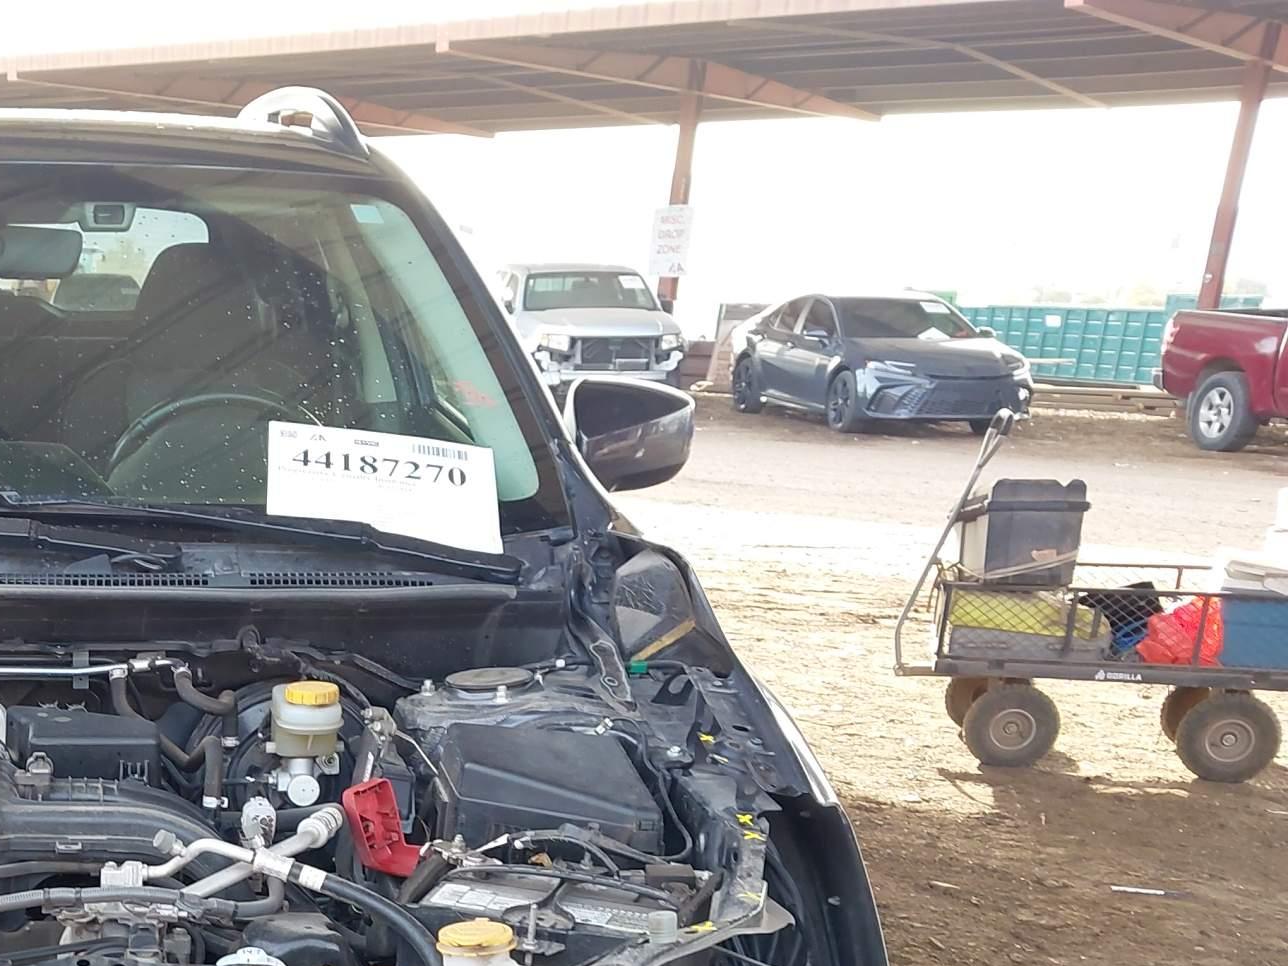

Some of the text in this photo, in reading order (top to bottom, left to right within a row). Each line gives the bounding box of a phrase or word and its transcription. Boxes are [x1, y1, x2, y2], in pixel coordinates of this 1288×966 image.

[657, 229, 686, 240] DROP
[655, 244, 682, 255] ZONE
[291, 448, 468, 487] 44187270
